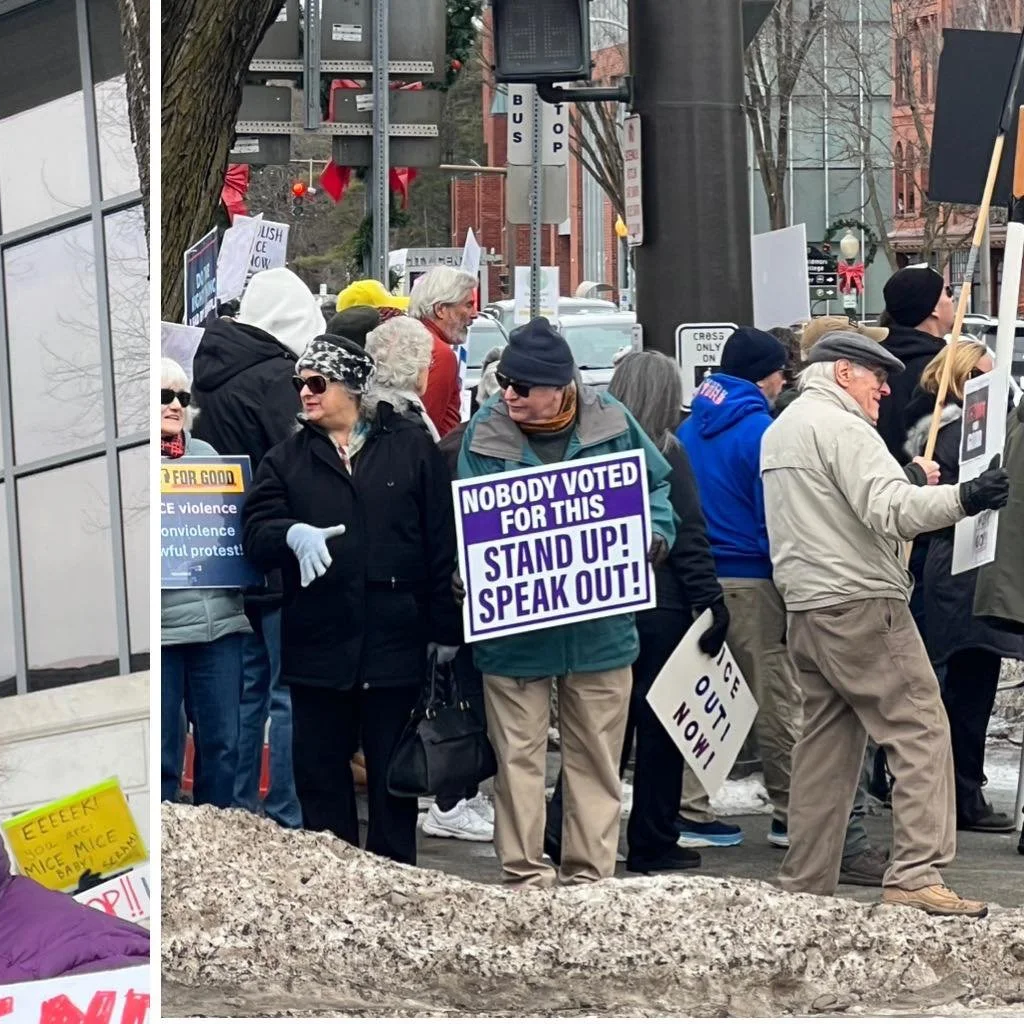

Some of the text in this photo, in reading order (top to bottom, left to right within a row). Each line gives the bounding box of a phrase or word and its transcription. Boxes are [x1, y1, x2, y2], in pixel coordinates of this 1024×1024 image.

[512, 94, 523, 143] BUS
[553, 104, 564, 153] TOP
[258, 226, 283, 243] LISH
[255, 240, 267, 253] CE
[435, 255, 463, 266] CEN
[693, 332, 724, 341] CROSS
[696, 343, 721, 352] ONLY
[703, 354, 716, 363] ON
[172, 469, 235, 486] FOR GOOD
[461, 461, 638, 514] NOBODY VOTED
[179, 502, 238, 514] violence
[500, 494, 605, 535] FOR THIS
[161, 524, 236, 537] onviolence
[191, 543, 244, 558] protest!
[483, 523, 629, 583] STAND UP!
[478, 561, 641, 624] SPEAK OUT!
[716, 645, 741, 700] ICE
[694, 674, 732, 742] OUT!
[672, 700, 716, 770] NOW!
[73, 830, 117, 858] MICE
